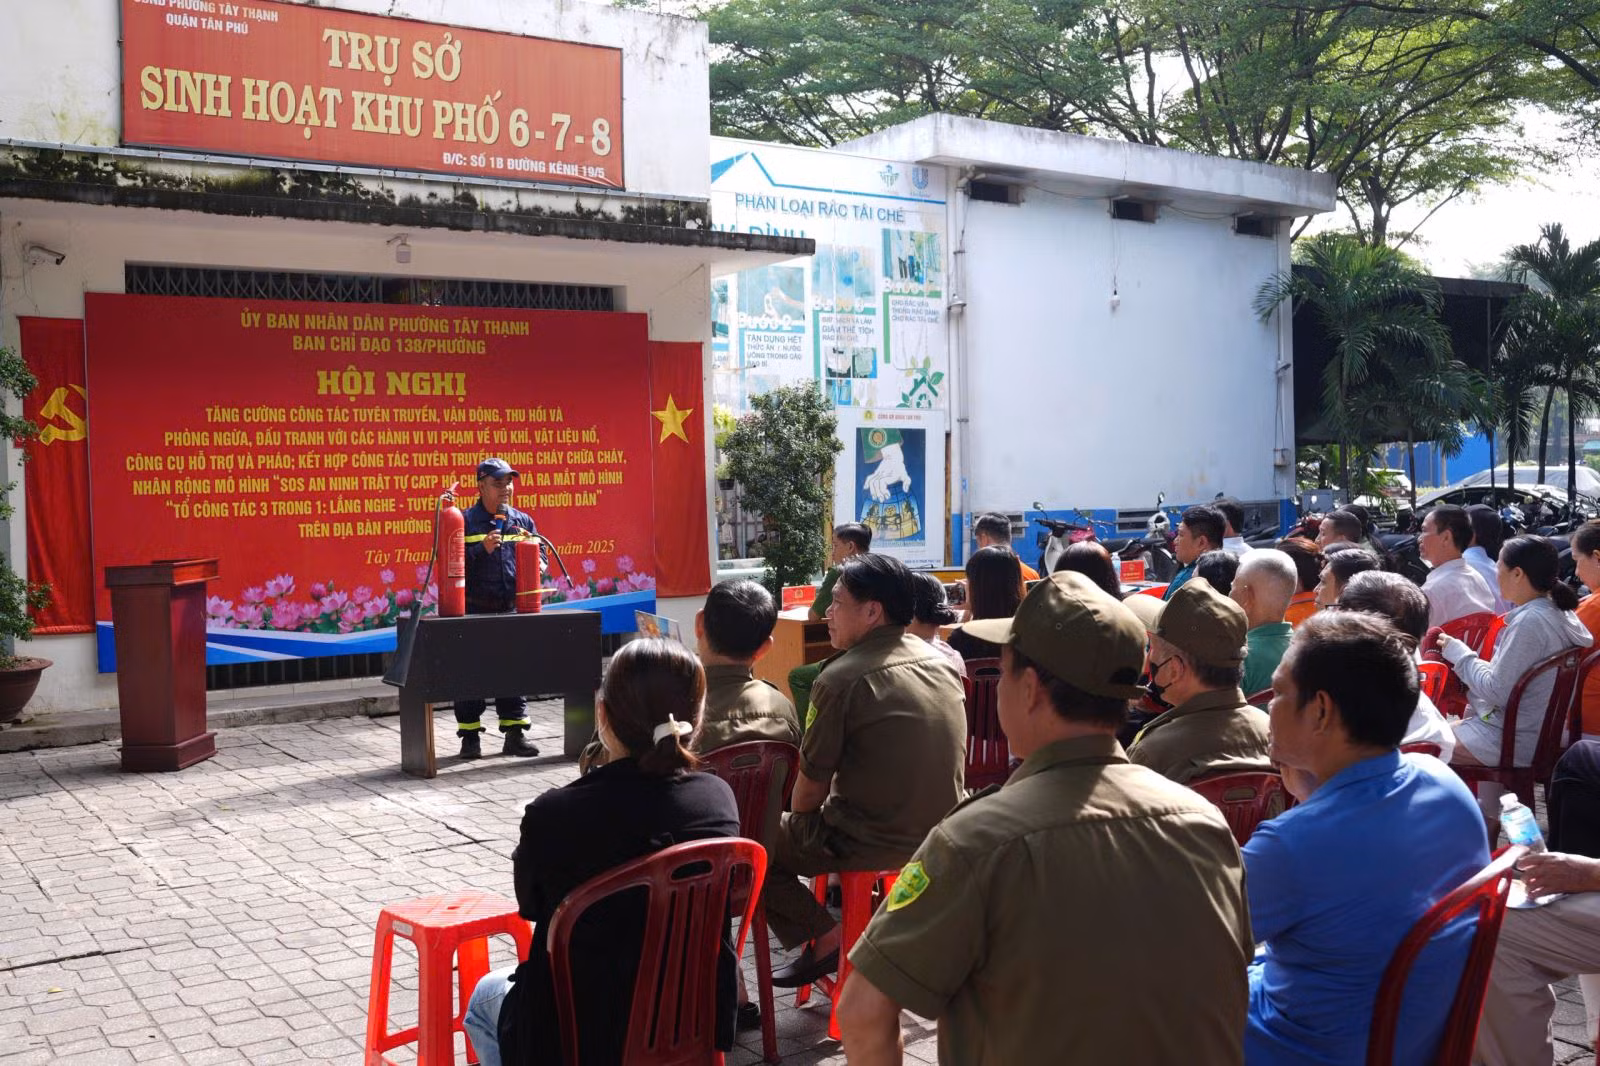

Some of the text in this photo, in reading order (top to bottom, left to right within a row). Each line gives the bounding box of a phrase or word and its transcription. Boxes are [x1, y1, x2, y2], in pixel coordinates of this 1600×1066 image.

[166, 13, 249, 35] QUẬN TÂN PHÚ
[218, 3, 240, 17] TÂY
[242, 7, 279, 22] THẠNH
[322, 28, 462, 87] TRỤ SỞ
[140, 65, 232, 118] SINH
[242, 77, 343, 140] HOẠT
[351, 90, 424, 137] KHU
[432, 90, 502, 145] PHỐ
[470, 152, 486, 168] SỐ
[507, 156, 546, 172] ĐƯỜNG
[549, 160, 579, 176] KÊNH
[735, 192, 905, 223] PHÂN LOẠI RÁC TÁI CHẾ
[241, 307, 530, 338] ỦY BAN NHÂN DÂN PHƯỜNG TÂY THẠNH
[293, 332, 486, 356] BAN CHỈ ĐẠO 138/PHƯỜNG
[316, 364, 466, 403] HỘI NGHỊ
[206, 405, 240, 422] TĂNG
[243, 405, 286, 422] CƯỜNG
[290, 405, 324, 422] CÔNG
[327, 405, 350, 422] TÁC
[353, 405, 391, 422] TUYÊN
[443, 405, 466, 425] VẬN
[469, 405, 503, 425] ĐỘNG,
[505, 408, 526, 422] THU
[549, 406, 564, 422] VÀ
[164, 428, 210, 446] PHÒNG
[213, 428, 253, 448] NGỪA,
[255, 426, 281, 446] ĐẤU
[284, 431, 324, 446] TRANH
[328, 427, 347, 445] VỚI
[350, 427, 374, 445] CÁC
[377, 427, 410, 445] HÀNH
[413, 430, 424, 444] VI
[427, 430, 438, 444] VI
[441, 430, 474, 447] PHẠM
[493, 427, 508, 444] VŨ
[510, 427, 532, 445] KHÍ,
[535, 427, 554, 446] VẬT
[557, 427, 579, 446] LIỆU
[126, 452, 163, 471] CÔNG
[167, 455, 185, 474] CỤ
[189, 450, 206, 470] HỖ
[209, 453, 235, 473] TRỢ
[237, 452, 254, 470] VÀ
[257, 452, 295, 471] PHÁO;
[298, 450, 320, 468] KẾT
[324, 452, 348, 471] HỢP
[351, 450, 384, 468] CÔNG
[387, 450, 409, 467] TÁC
[412, 449, 448, 467] TUYÊN
[536, 448, 564, 464] CHÁY
[566, 448, 595, 464] CHỮA
[133, 476, 171, 495] NHÂN
[175, 476, 210, 498] RỘNG
[214, 475, 235, 494] MÔ
[239, 475, 270, 493] HÌNH
[308, 477, 326, 492] AN
[329, 476, 358, 491] NINH
[362, 473, 391, 493] TRẬT
[393, 474, 409, 493] TỰ
[411, 474, 439, 489] CATP
[520, 471, 534, 486] VÀ
[537, 472, 550, 486] RA
[553, 468, 575, 486] MẮT
[579, 469, 596, 485] MÔ
[598, 469, 623, 485] HÌNH
[193, 500, 229, 518] CÔNG
[232, 499, 257, 517] TÁC
[260, 502, 268, 516] 3
[271, 500, 312, 516] TRONG
[315, 500, 327, 514] 1:
[330, 494, 361, 514] LẮNG
[364, 498, 396, 513] NGHE
[516, 493, 538, 511] TRỢ
[540, 490, 573, 507] NGƯỜI
[298, 516, 432, 540] TRÊN ĐỊA BÀN PHƯỜNG
[365, 550, 390, 567] Tây
[557, 542, 583, 556] năm
[587, 539, 615, 554] 2025
